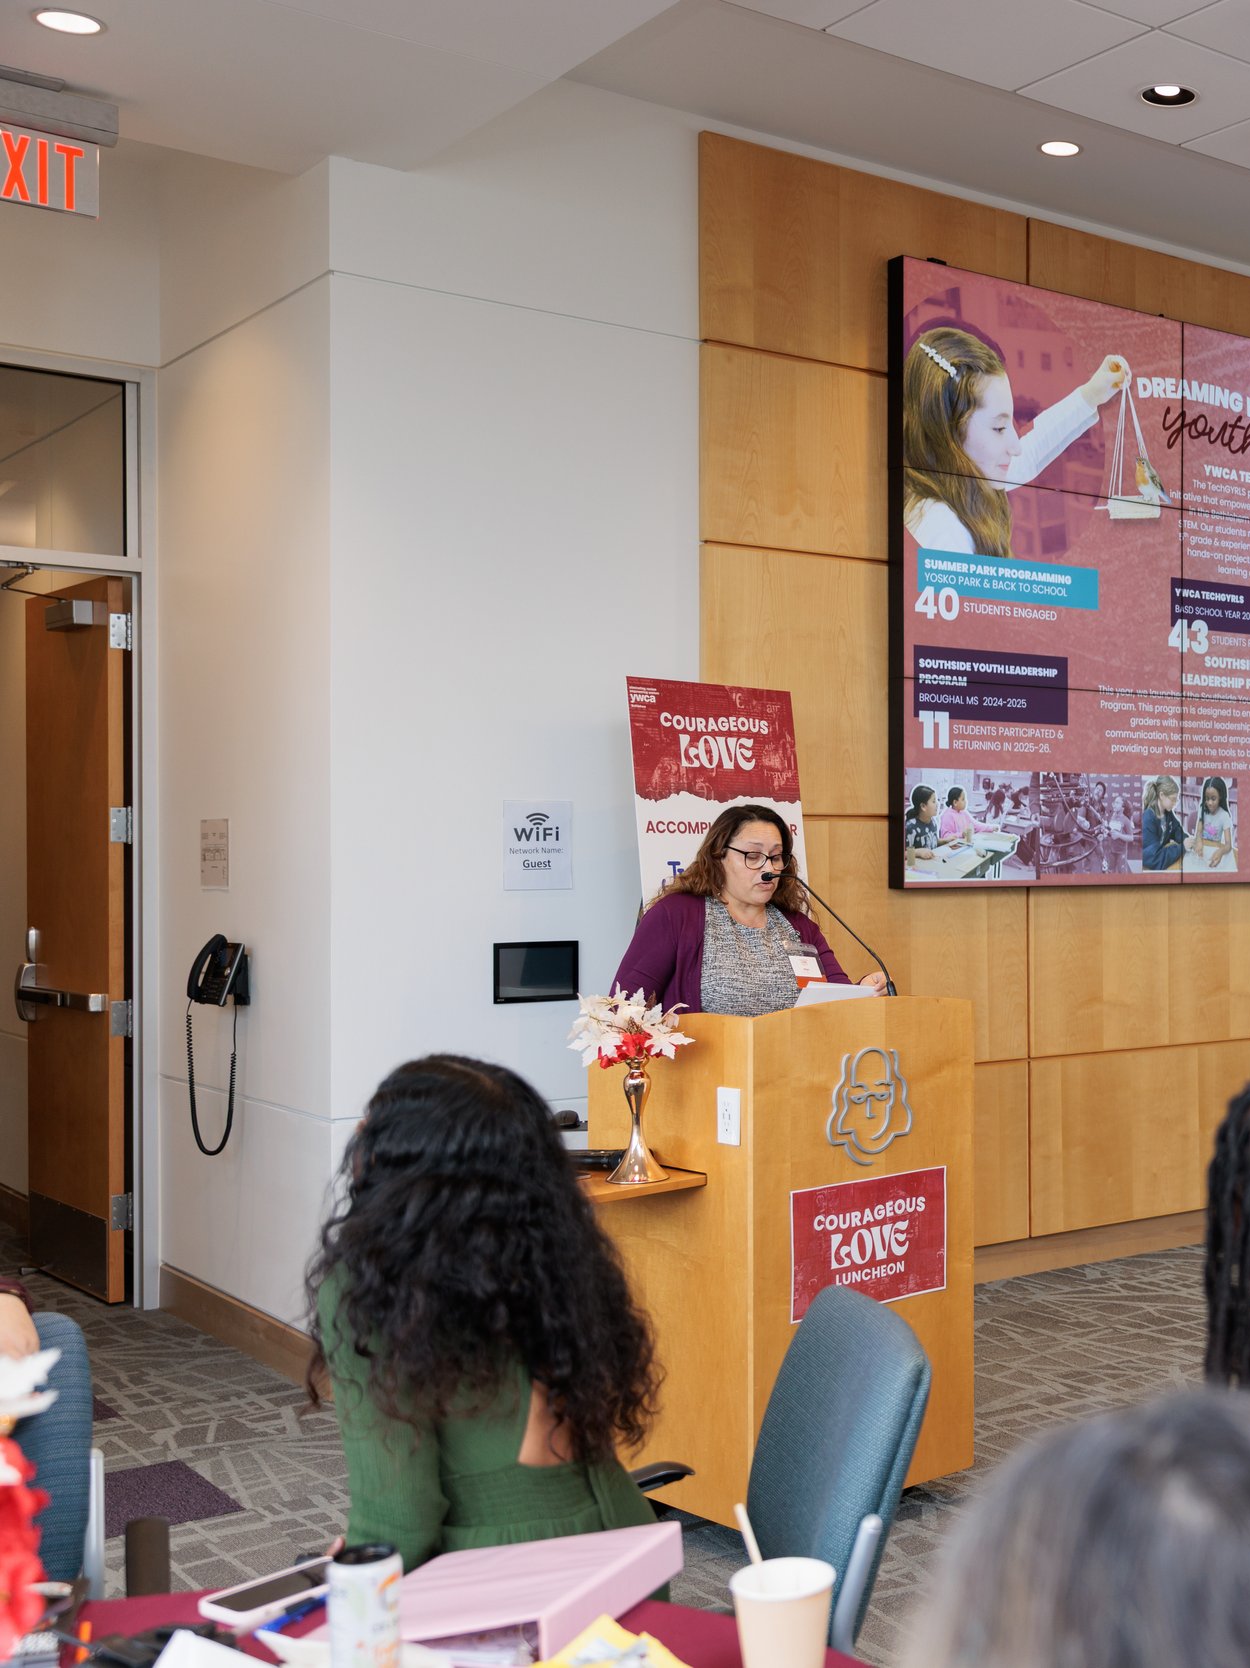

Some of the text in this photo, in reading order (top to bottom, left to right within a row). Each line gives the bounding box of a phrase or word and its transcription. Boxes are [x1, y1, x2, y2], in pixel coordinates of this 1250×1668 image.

[0, 130, 84, 210] XIT
[1137, 377, 1243, 412] DREAMING
[1204, 464, 1238, 480] YWCA
[1193, 480, 1206, 489] The
[1208, 482, 1246, 496] TechGYRLS
[1170, 489, 1202, 502] initative
[1203, 495, 1218, 505] that
[1200, 523, 1213, 531] Our
[1216, 524, 1246, 536] students
[1190, 535, 1212, 545] grade
[1214, 538, 1219, 546] &
[1187, 548, 1223, 559] hands-on
[925, 559, 1071, 584] SUMMER PARK PROGRAMMING
[1218, 565, 1247, 579] learning
[925, 572, 1067, 597] YOSKO PARK & BACK TO SCHOOL
[915, 586, 1057, 621] 40 STUDENTS ENGAGED
[1175, 588, 1244, 604] YWCA TECHGYRLS
[1195, 606, 1223, 618] SCHOOL
[1225, 611, 1240, 619] YEAR
[1168, 619, 1208, 654] 43
[1212, 636, 1246, 647] STUDENTS
[919, 658, 1058, 677] SOUTHSIDE YOUTH LEADERSHIP
[919, 673, 967, 686] PROGRAM
[1182, 673, 1244, 689] LEADERSHIP
[630, 694, 656, 703] ywca
[919, 693, 1027, 708] BROUGHAL MS 2024-2025
[1100, 700, 1136, 712] Program.
[1138, 702, 1152, 712] This
[1155, 705, 1188, 715] program
[1198, 706, 1231, 718] designed
[660, 712, 768, 734] COURAGEOUS
[919, 710, 1064, 749] 11 STUDENTS PARTICIPATED &
[1130, 717, 1160, 728] graders
[1162, 718, 1178, 727] with
[679, 734, 755, 771] LOVE
[953, 740, 1000, 751] RETURNING
[1003, 742, 1011, 751] IN
[1111, 744, 1148, 756] providing
[1150, 746, 1162, 754] our
[1188, 747, 1203, 755] with
[1205, 748, 1216, 756] the
[1218, 748, 1236, 756] tools
[1194, 760, 1222, 769] makers
[1232, 762, 1248, 770] their
[514, 827, 559, 842] WiFi
[646, 820, 711, 835] ACCOMP
[523, 860, 551, 868] Guest
[814, 1196, 925, 1231] COURAGEOUS
[831, 1220, 909, 1270] LOVE
[836, 1261, 905, 1286] LUNCHEON
